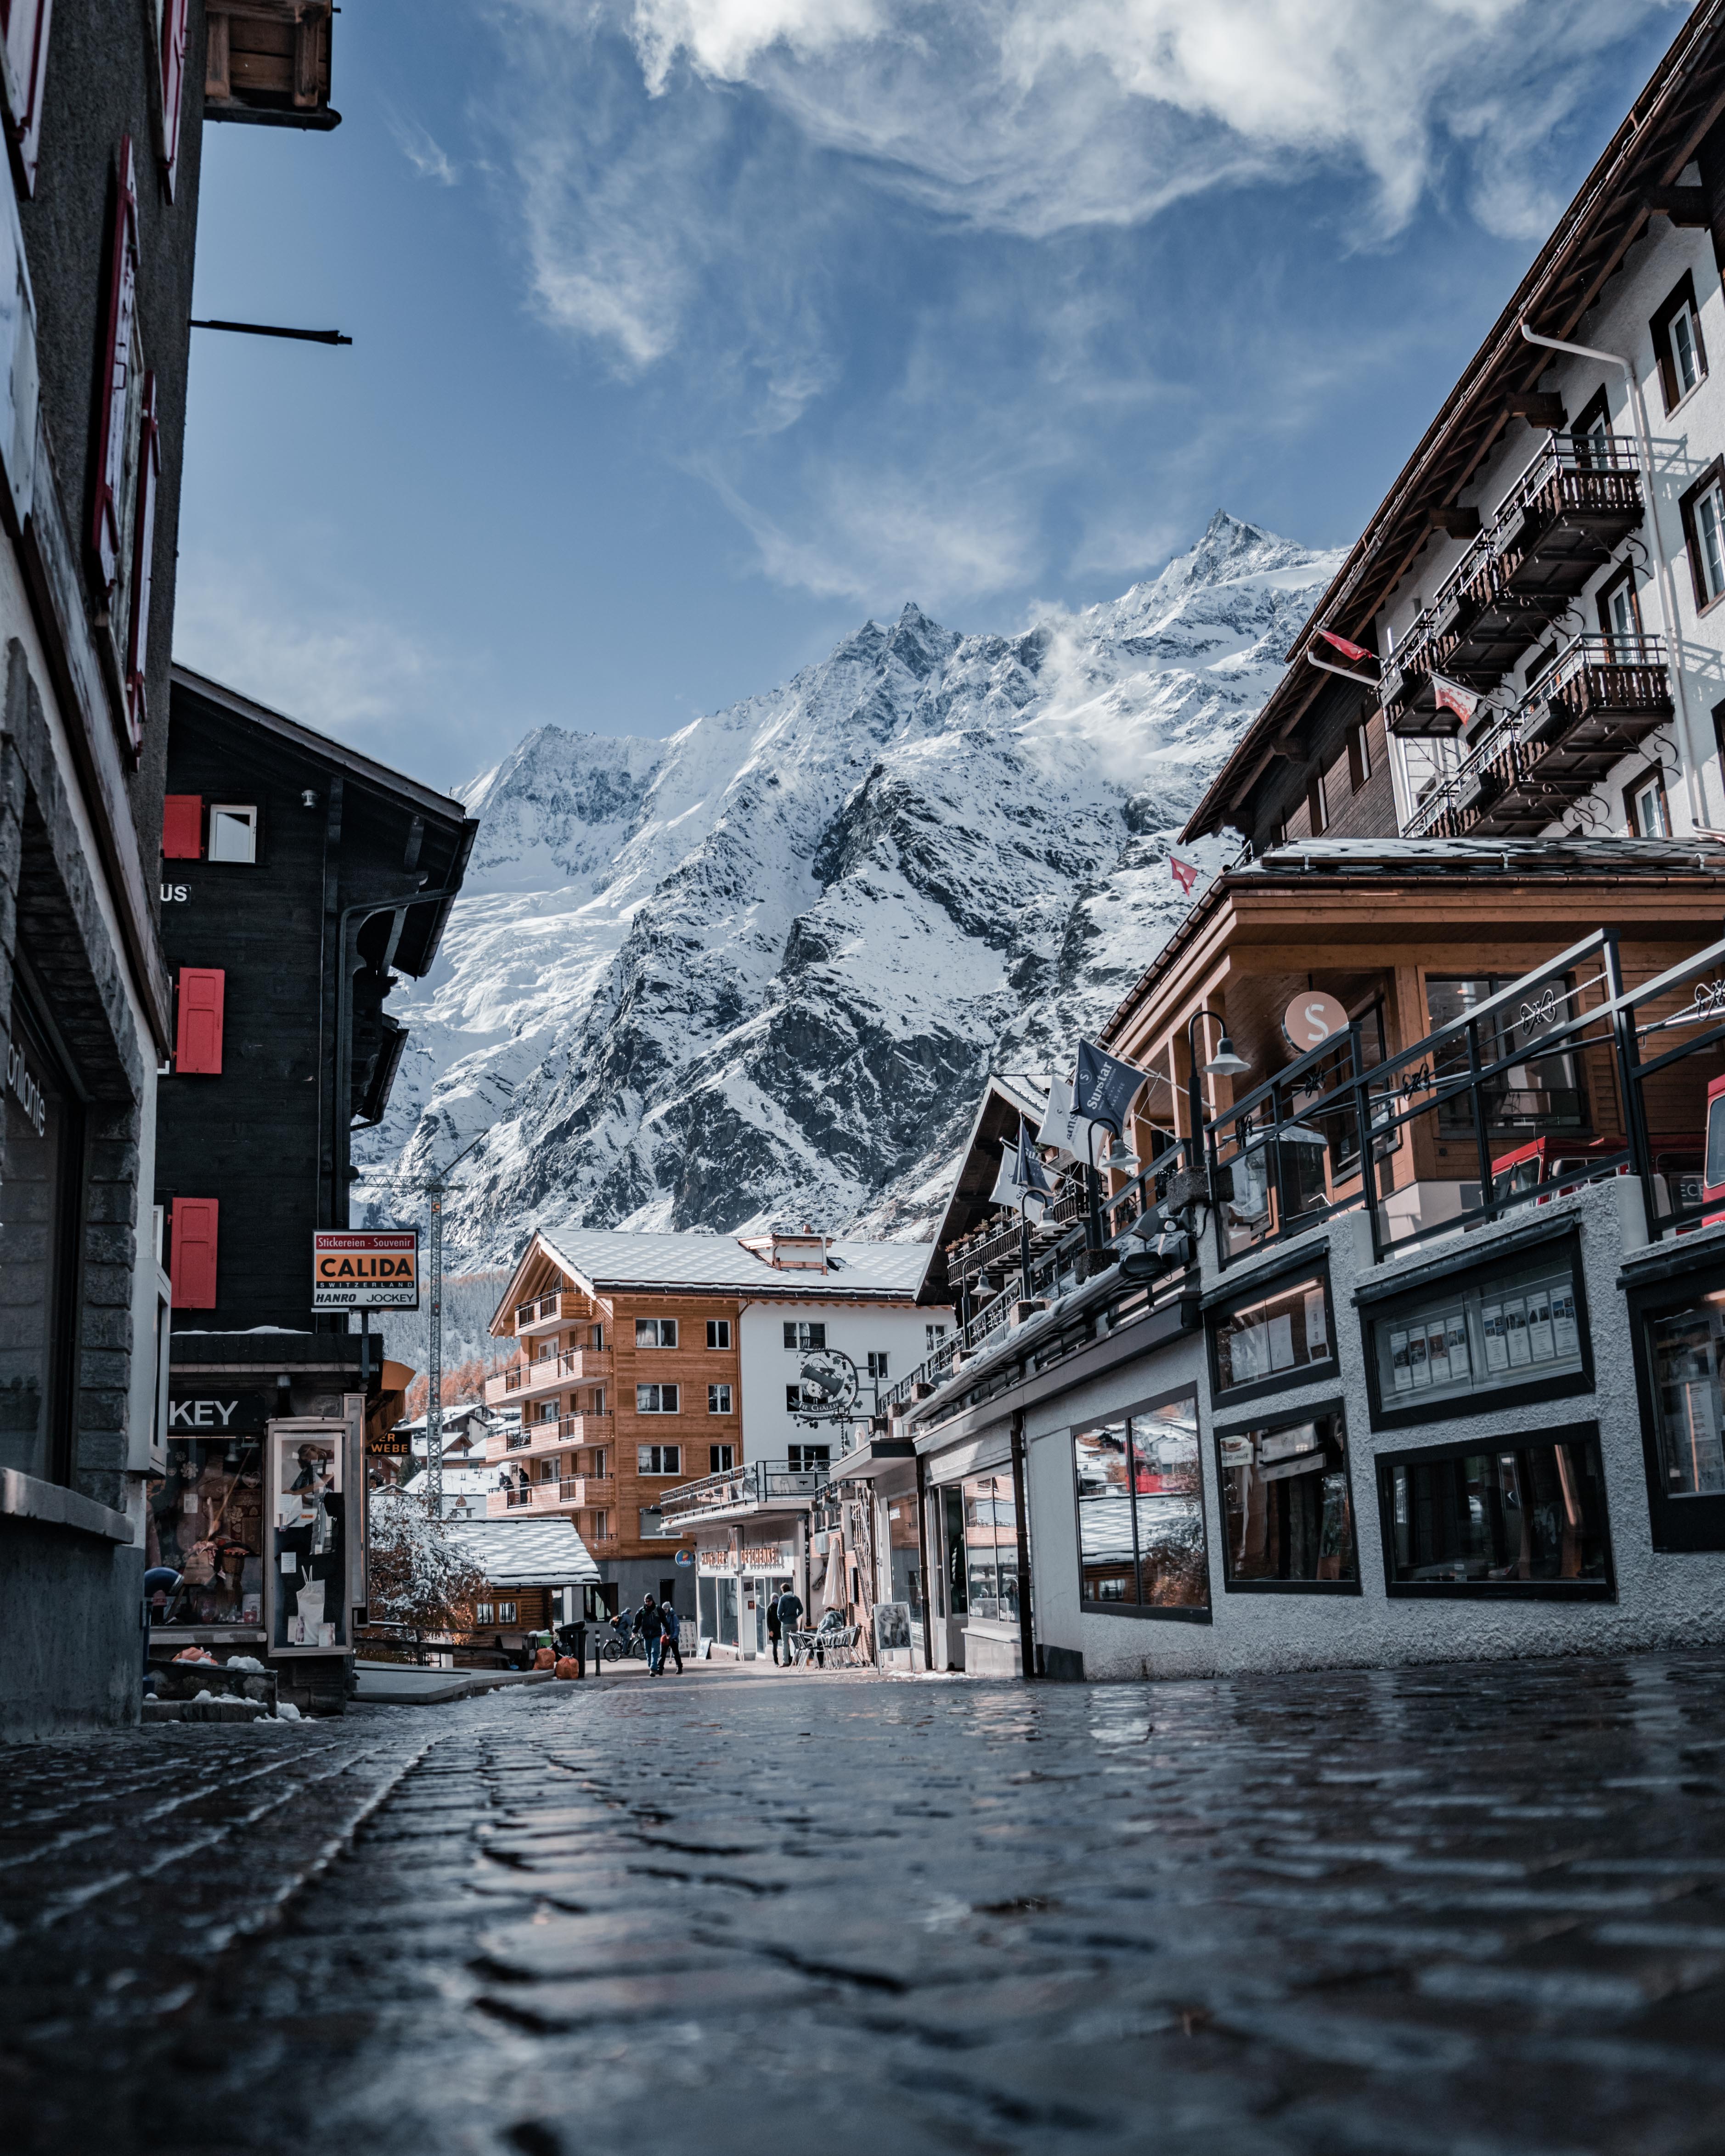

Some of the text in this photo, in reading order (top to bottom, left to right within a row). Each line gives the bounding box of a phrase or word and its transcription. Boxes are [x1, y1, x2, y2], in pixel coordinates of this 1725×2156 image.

[1305, 1003, 1329, 1041] S
[318, 1237, 365, 1247] Stickereien
[373, 1237, 411, 1247] Souvenir
[320, 1258, 412, 1277] CALIDA
[316, 1294, 414, 1303] HANRO JOCKEY
[169, 1401, 239, 1425] KEY
[371, 1444, 408, 1453] WEBE
[701, 1552, 713, 1565] HAUS
[740, 1548, 775, 1564] GESCHENKE
